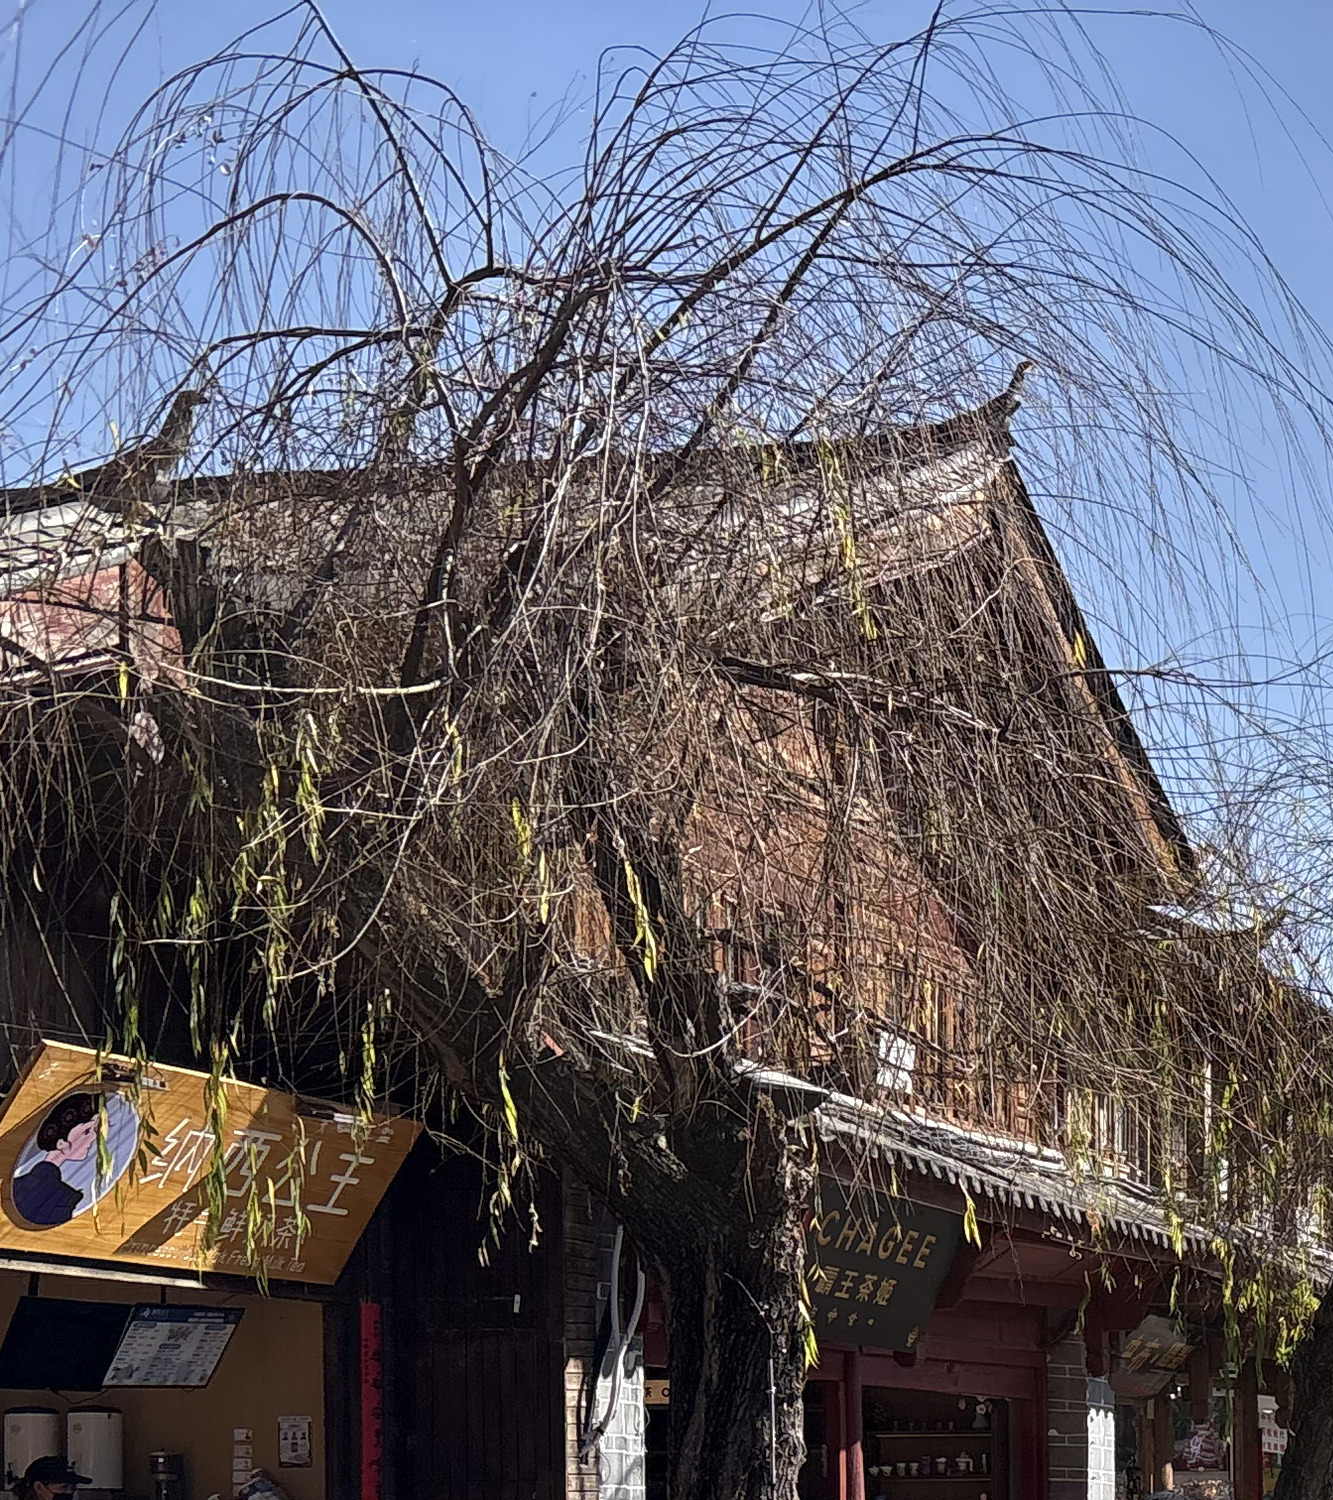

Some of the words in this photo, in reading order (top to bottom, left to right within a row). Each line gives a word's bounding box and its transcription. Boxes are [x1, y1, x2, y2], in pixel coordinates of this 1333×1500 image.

[817, 1210, 937, 1269] CHAGEE
[814, 1265, 898, 1307] 霸王茶姬
